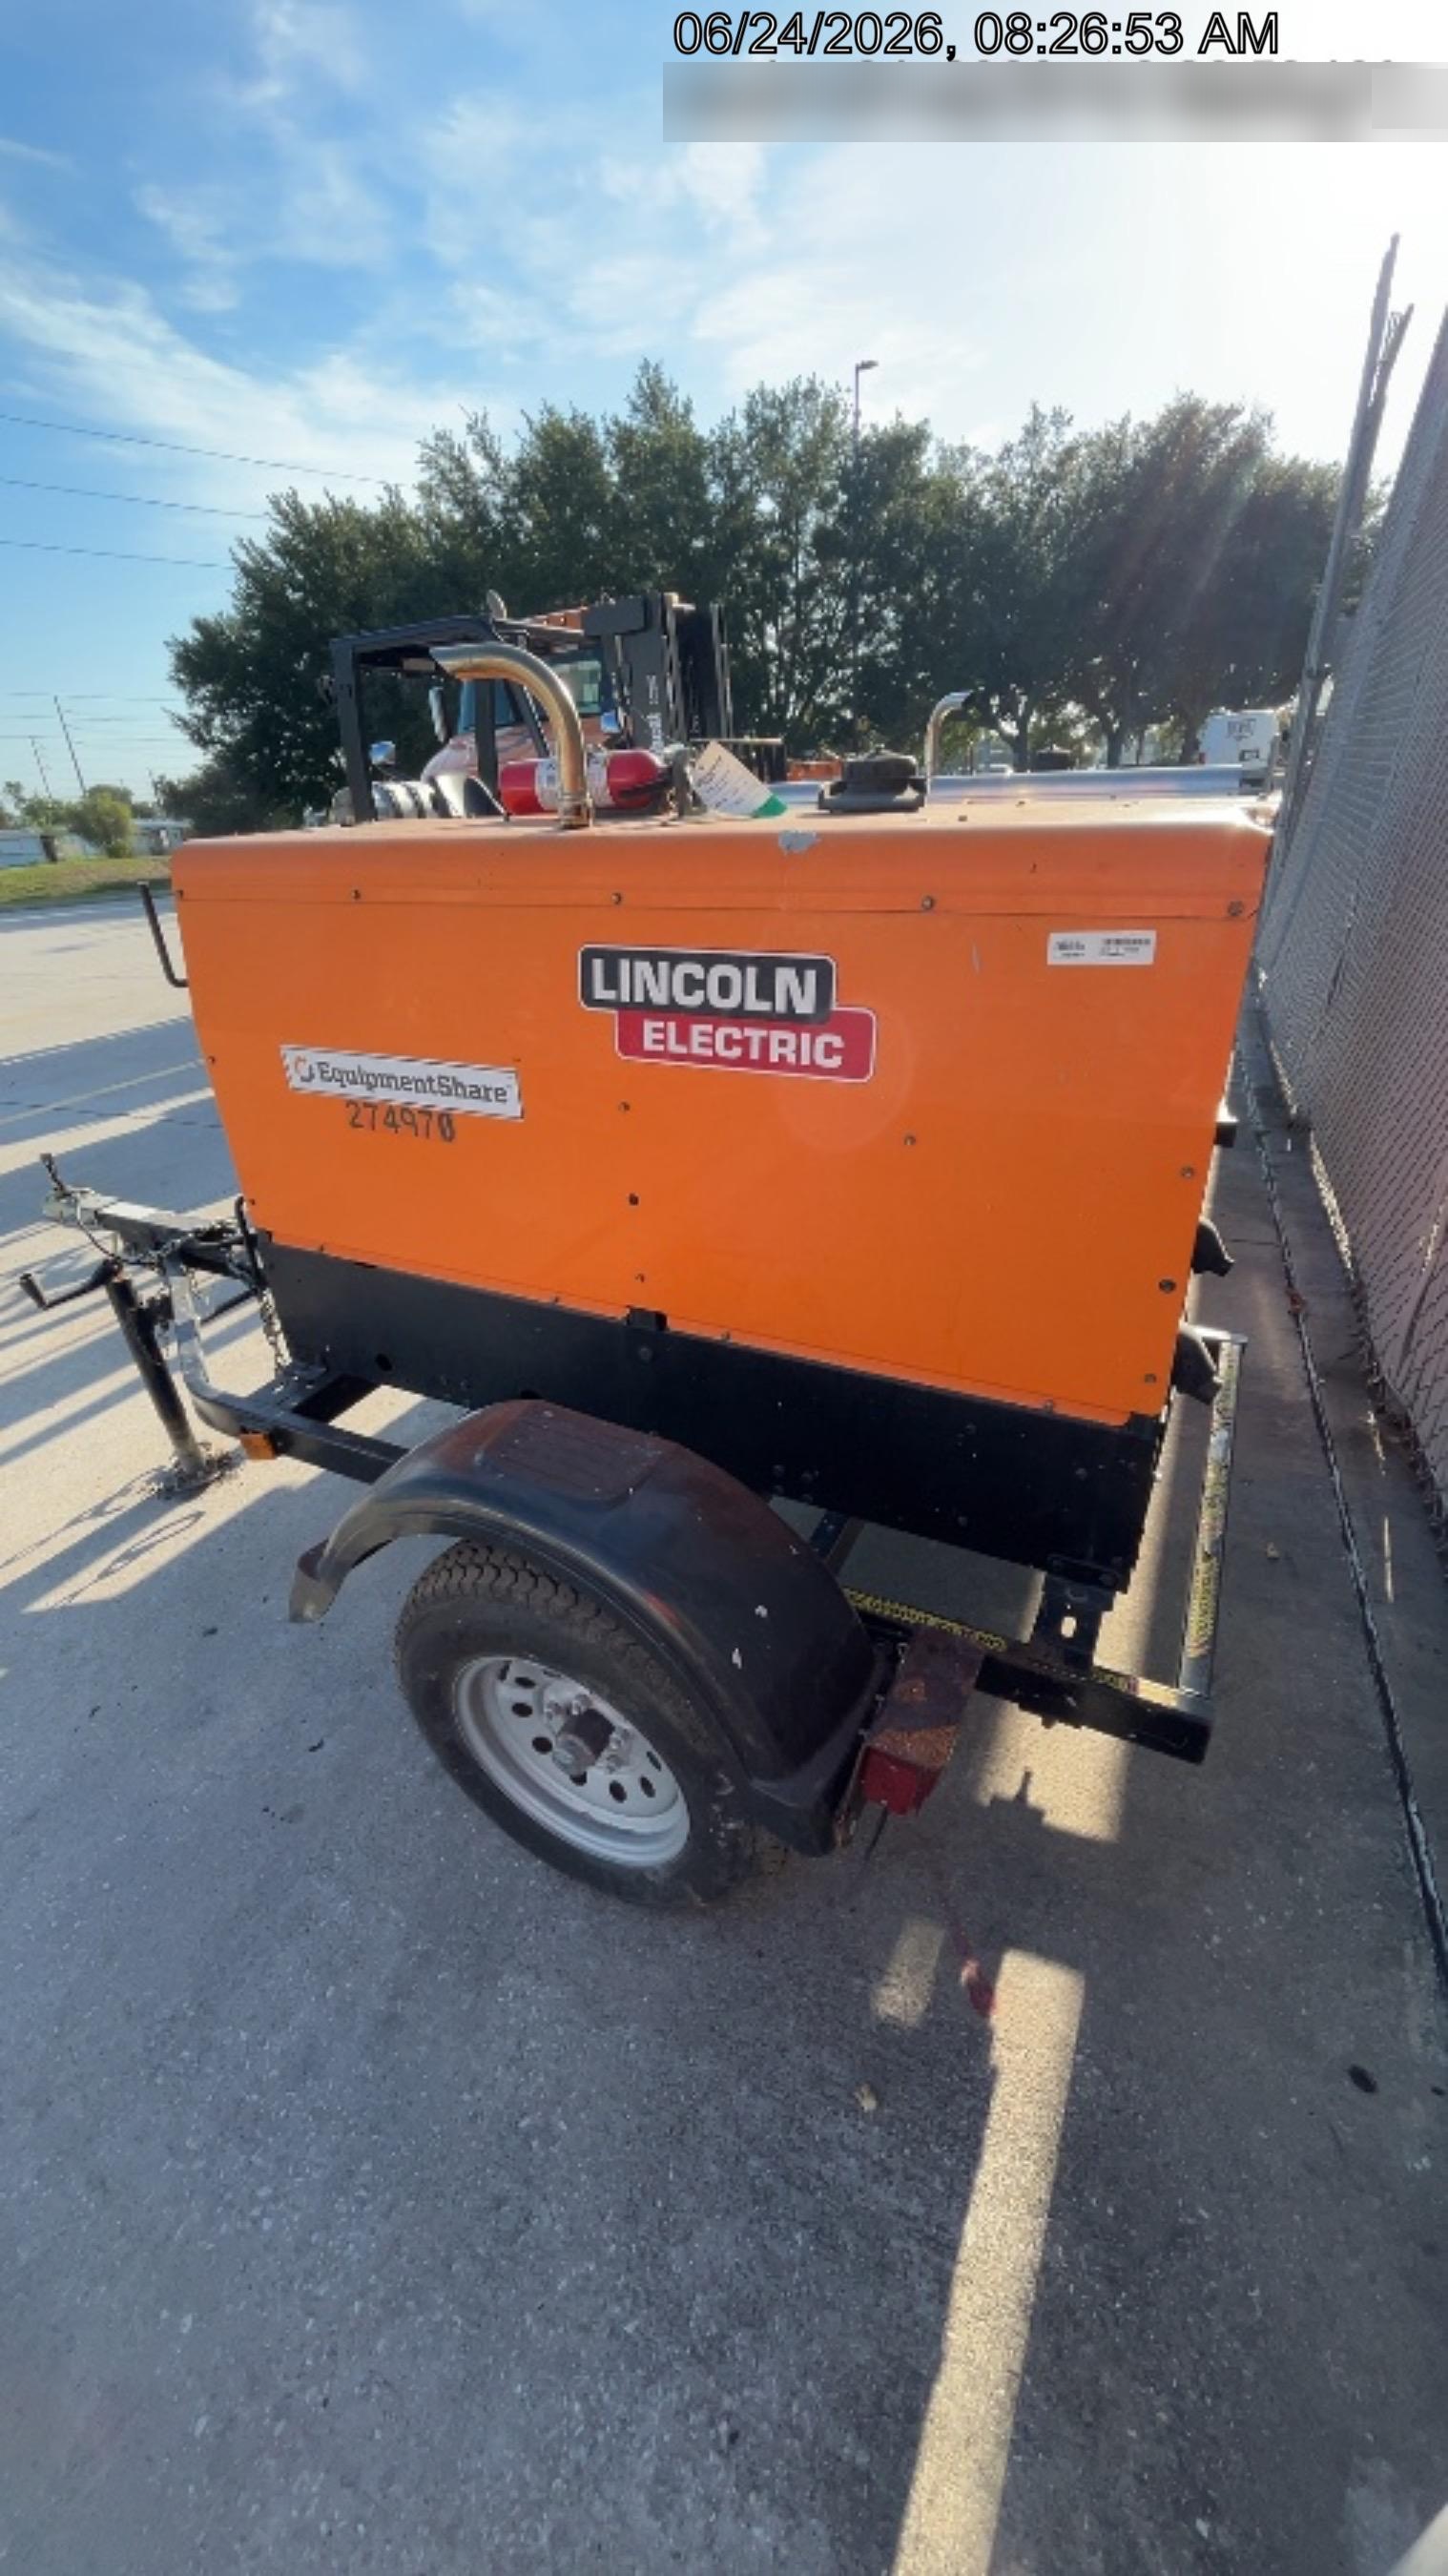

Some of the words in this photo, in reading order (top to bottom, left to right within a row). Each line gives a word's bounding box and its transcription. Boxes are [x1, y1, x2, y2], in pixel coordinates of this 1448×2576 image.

[591, 957, 817, 1015] LINCOLN
[643, 1018, 845, 1069] ELECTRIC
[316, 1061, 508, 1103] EquipmentShare
